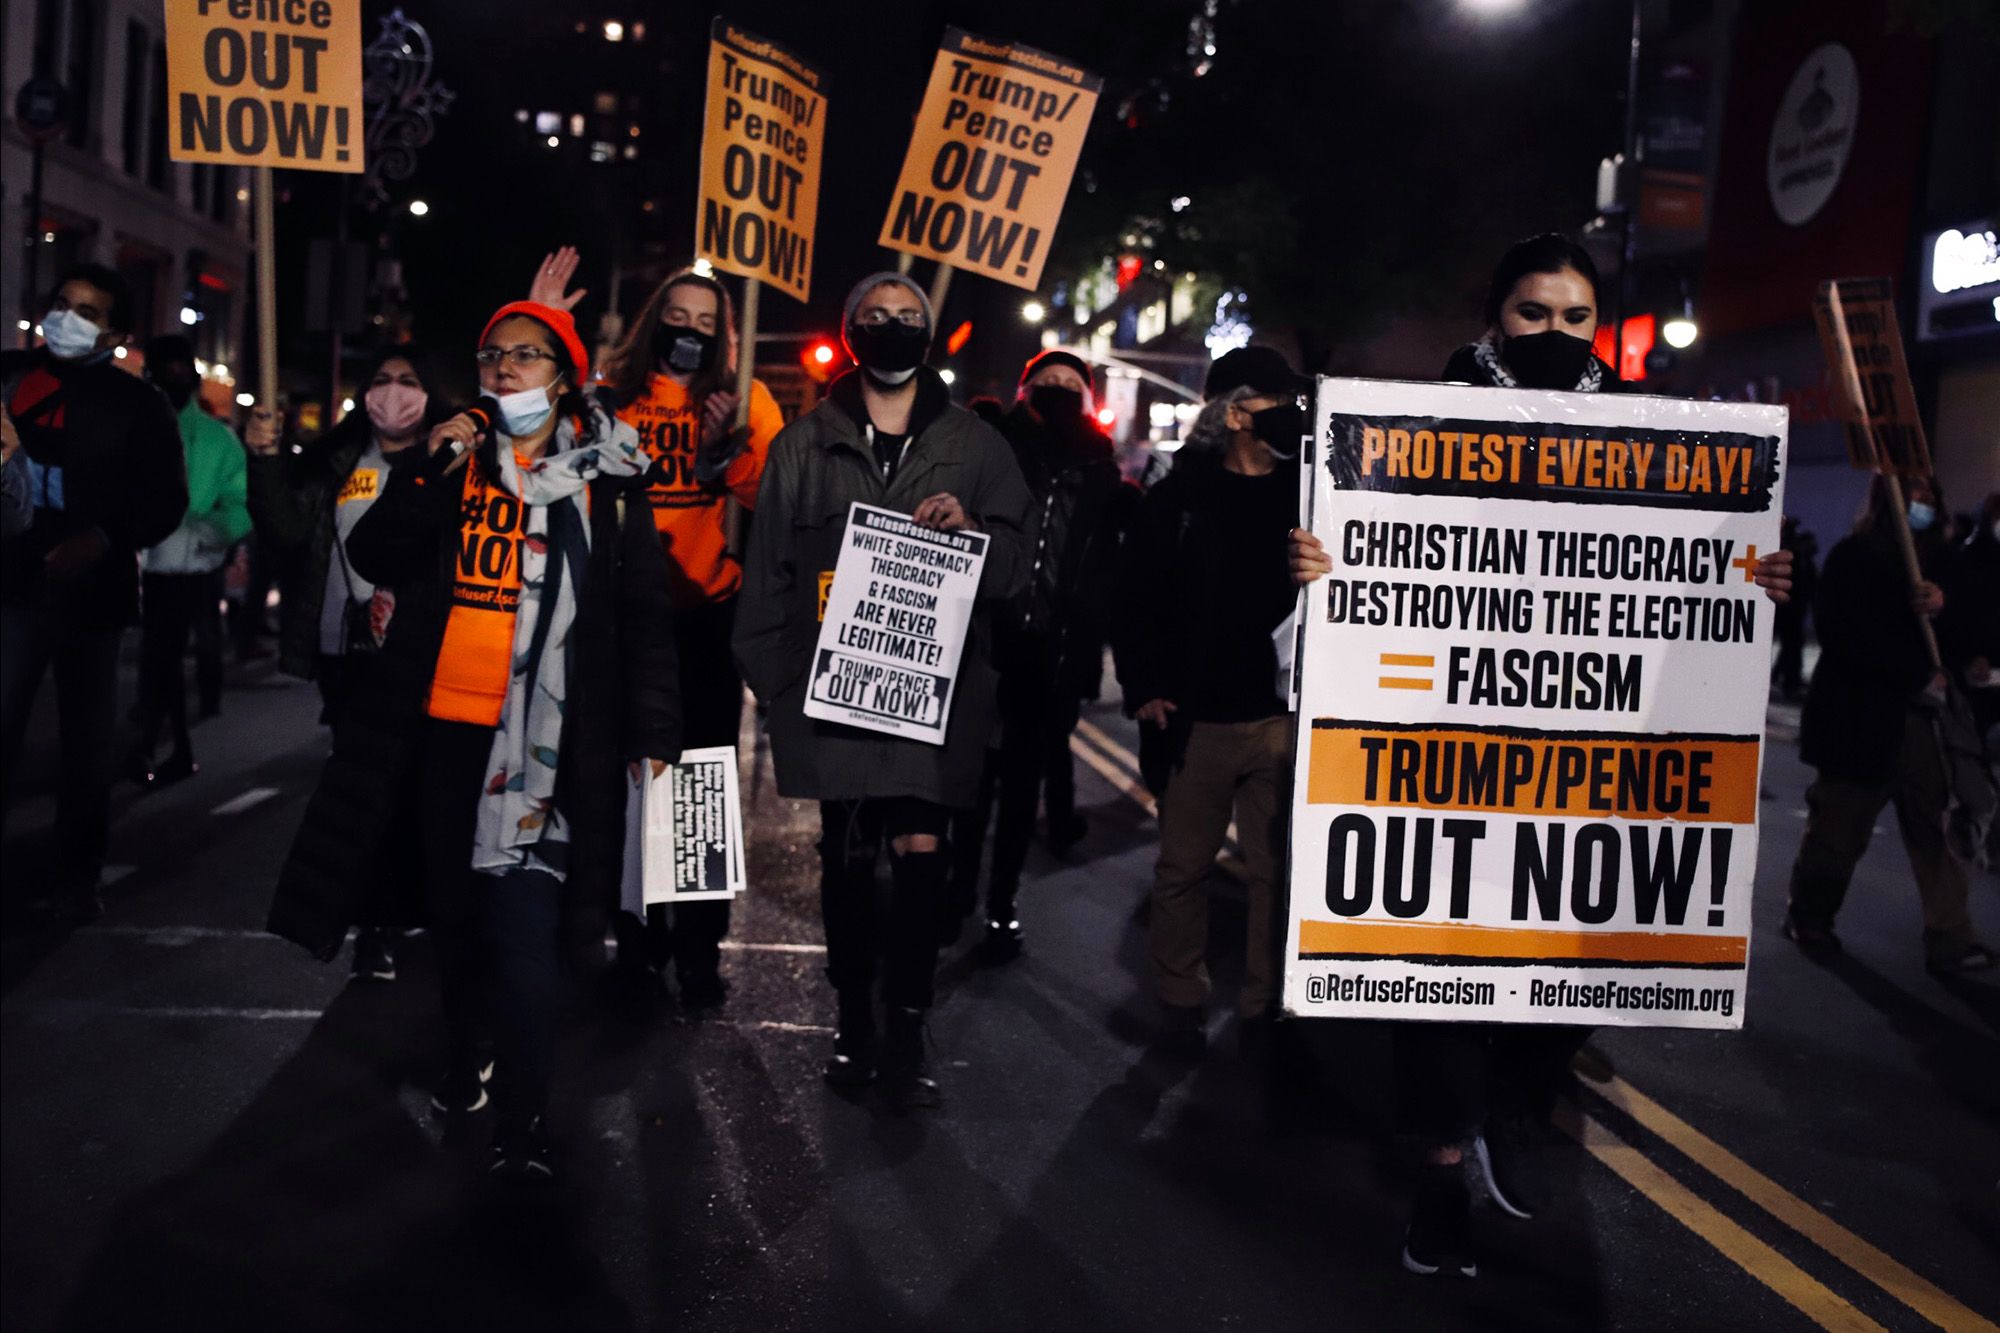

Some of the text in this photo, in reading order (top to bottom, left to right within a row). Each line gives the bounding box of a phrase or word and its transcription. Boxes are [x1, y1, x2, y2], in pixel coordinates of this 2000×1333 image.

[204, 27, 328, 93] OUT
[721, 52, 817, 127] Trump/
[950, 60, 1081, 123] Trump/
[180, 92, 349, 162] NOW!
[724, 96, 808, 164] Pence
[943, 98, 1054, 157] Pence
[724, 143, 803, 221] OUT
[931, 141, 1041, 211] OUT
[703, 197, 808, 291] NOW!
[890, 190, 1041, 277] NOW!
[1361, 426, 1753, 494] PROTEST EVERY DAY!
[852, 531, 893, 555] WHITE
[866, 513, 972, 552] RefuseFascism.org
[1343, 519, 1527, 575] CHRISTIAN
[868, 581, 938, 612] & FASCISM
[871, 557, 945, 589] THEOCRACY
[853, 600, 937, 637] ARE NEVER
[1327, 579, 1756, 643] DESTROYING THE ELECTION
[838, 623, 943, 667] LEGITIMATE!
[838, 658, 931, 695] TRUMP/PENCE
[828, 675, 930, 720] OUT NOW!
[1447, 646, 1643, 713] FASCISM
[1360, 737, 1713, 814] TRUMP/PENCE
[1325, 813, 1734, 927] OUT NOW!
[1306, 973, 1496, 1006] @RefuseFascism
[1530, 978, 1735, 1017] RefuseFascism.org
